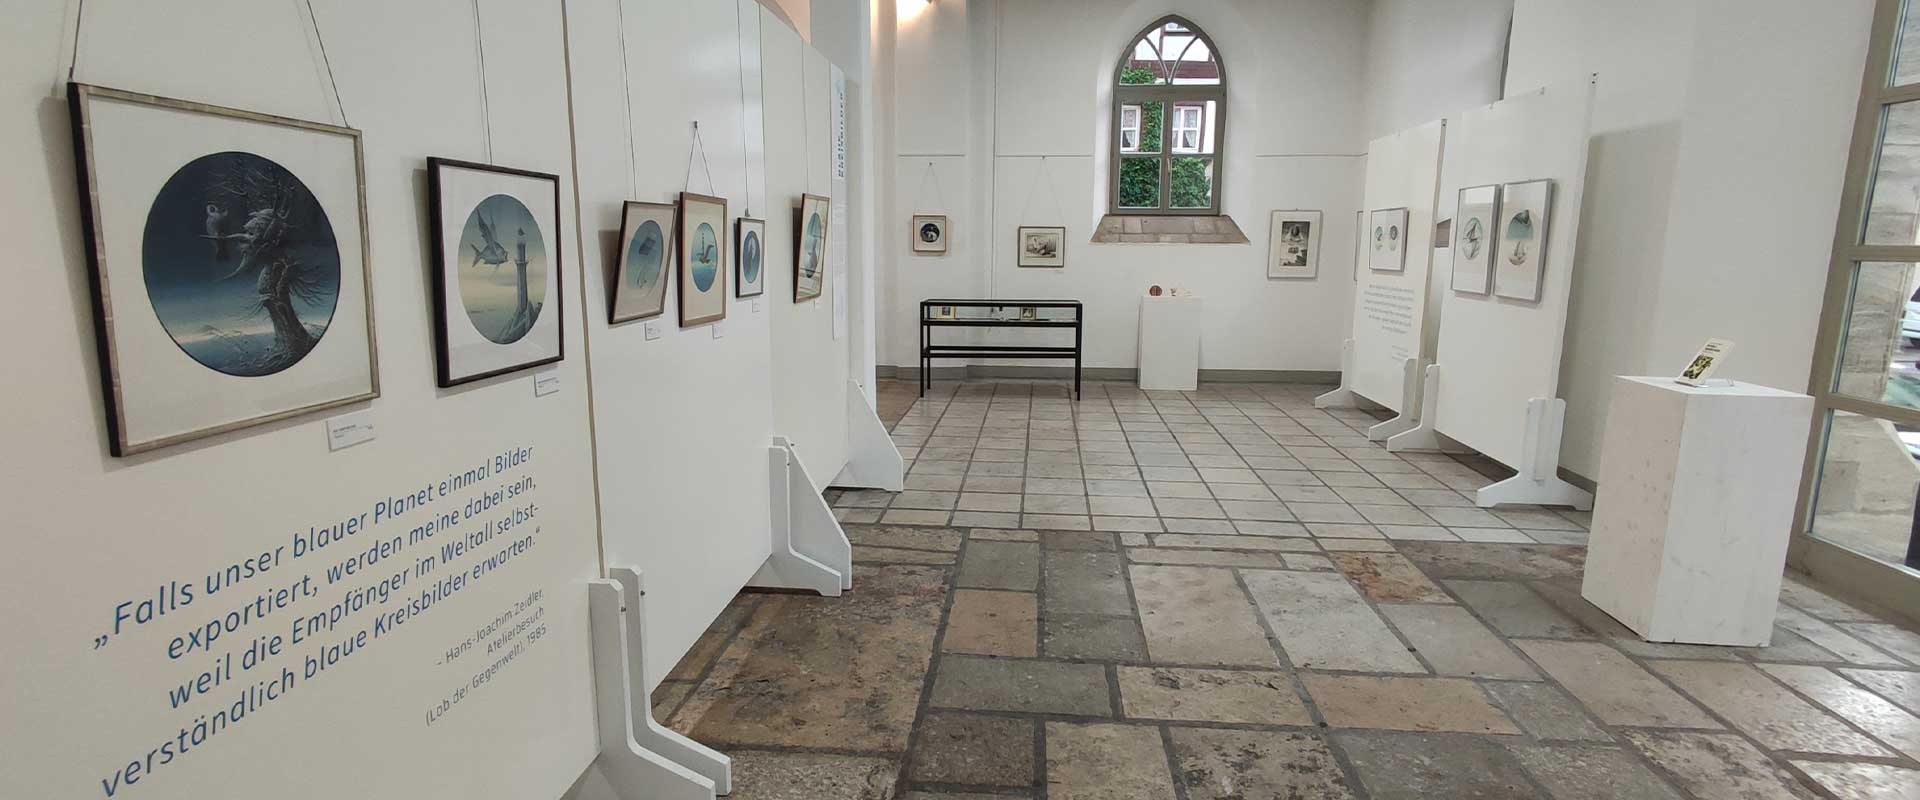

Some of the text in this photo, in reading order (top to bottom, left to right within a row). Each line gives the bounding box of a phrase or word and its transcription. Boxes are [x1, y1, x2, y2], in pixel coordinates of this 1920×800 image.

[167, 474, 537, 660] exportiert, werden meine dabei sein,
[205, 545, 285, 595] unser
[293, 511, 368, 560] blauer
[374, 483, 435, 525] Planet
[438, 457, 491, 497] einmal
[495, 446, 534, 474] Bilder
[168, 501, 539, 710] weil die Empfänger im Weltall selbst-
[425, 698, 451, 727] (Lob
[452, 683, 470, 705] der
[526, 622, 547, 646] 1985
[445, 610, 513, 664] Hans-Joachim
[487, 605, 545, 657] Atelierbesuch
[101, 667, 295, 798] verständlich
[304, 629, 367, 681] blaue
[373, 570, 469, 640] Kreisbilder
